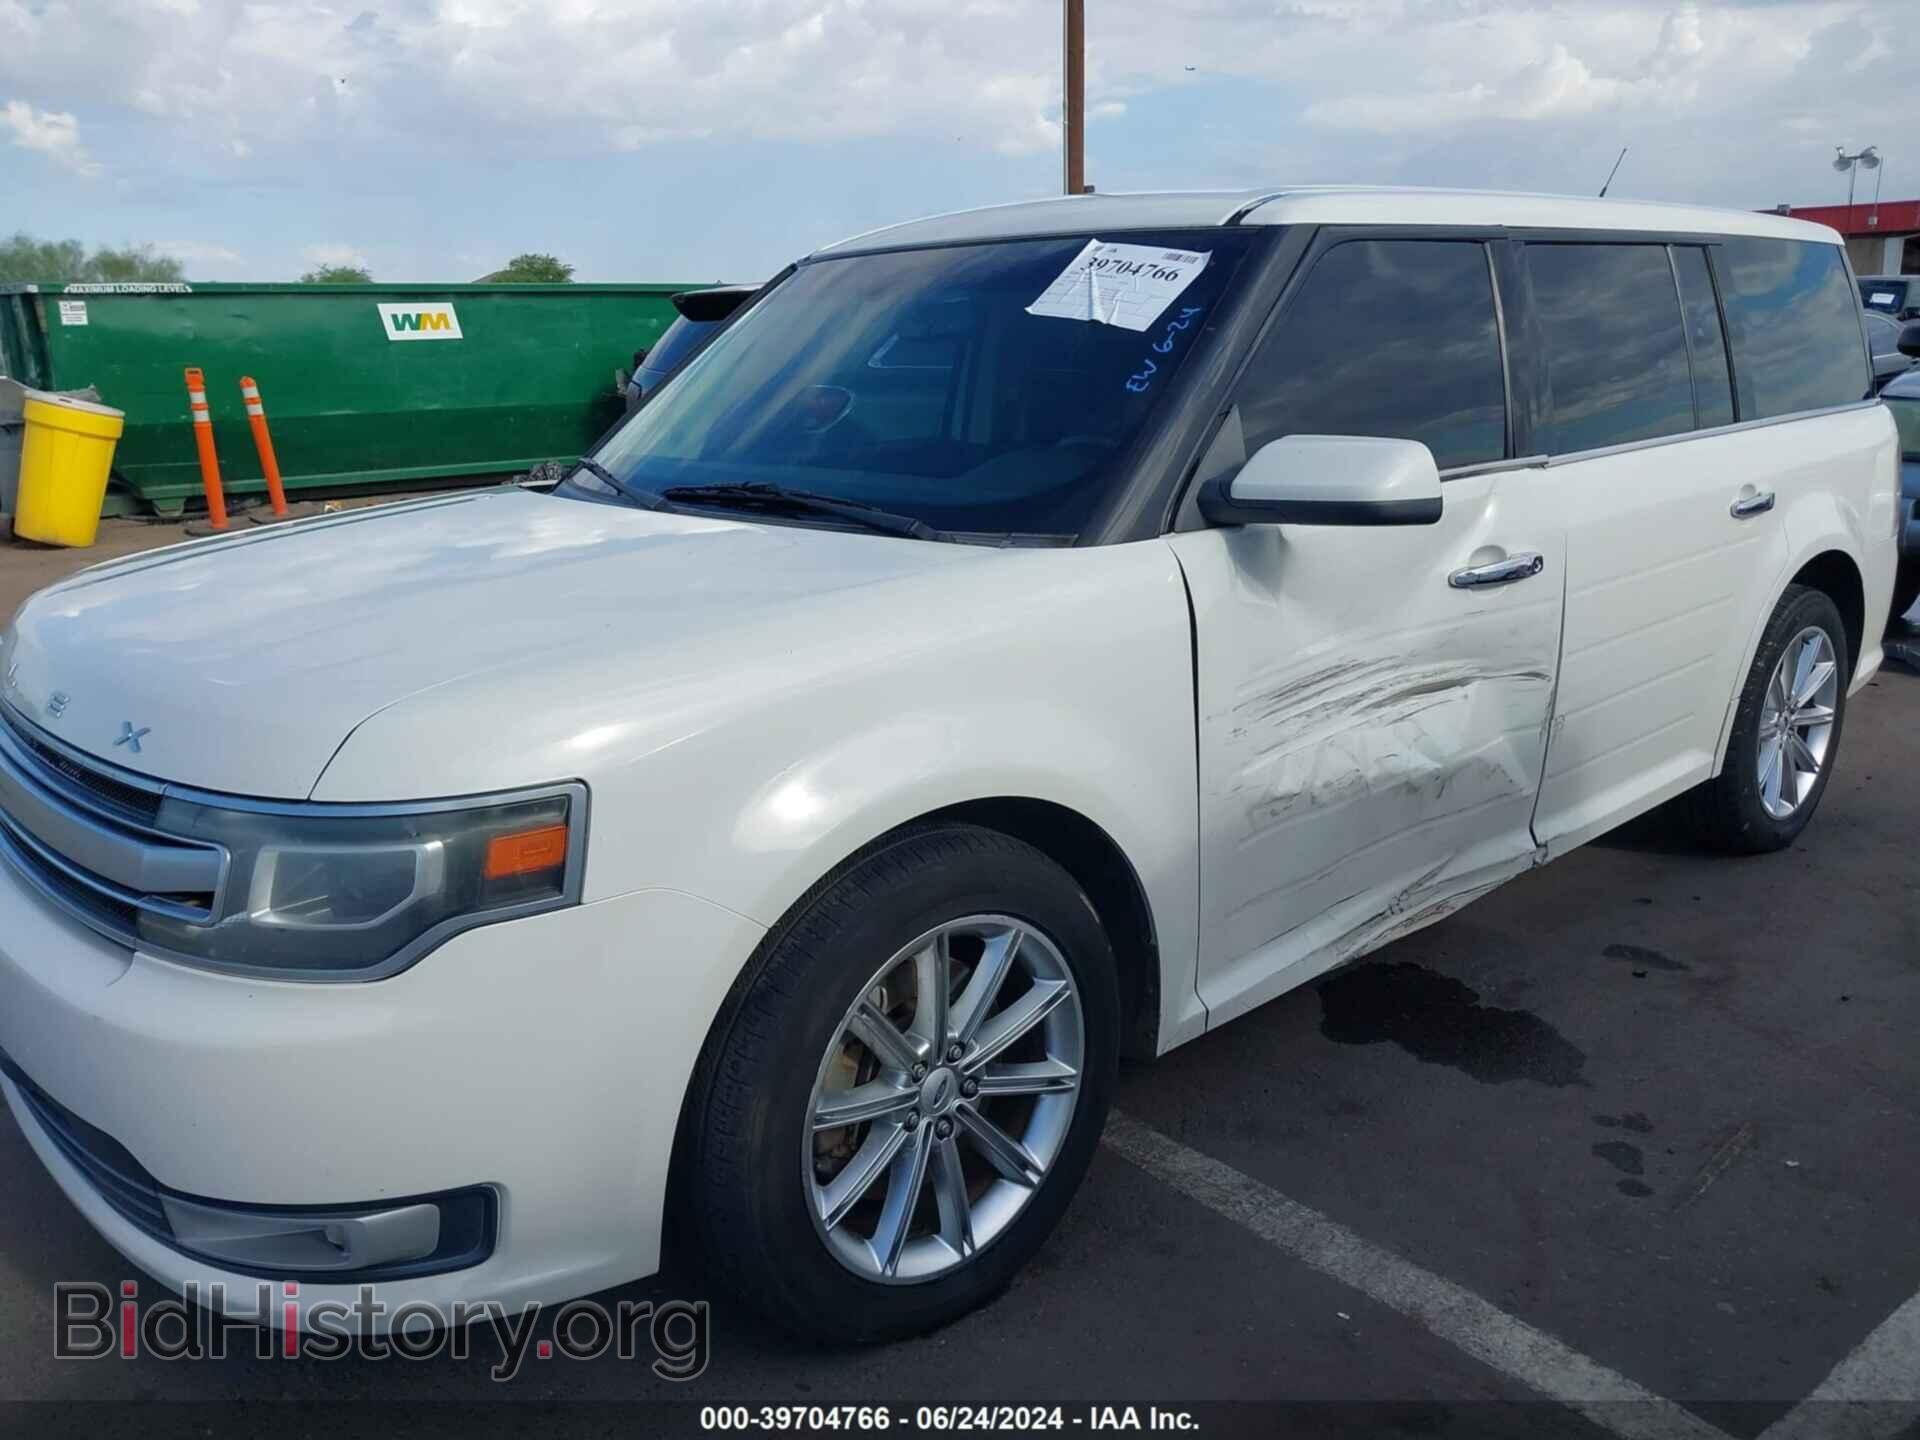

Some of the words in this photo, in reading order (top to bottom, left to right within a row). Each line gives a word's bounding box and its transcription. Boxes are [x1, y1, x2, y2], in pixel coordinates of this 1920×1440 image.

[1080, 256, 1185, 282] 39704766
[116, 282, 157, 294] LOADING
[158, 282, 187, 294] LEVEL
[390, 312, 450, 331] WM
